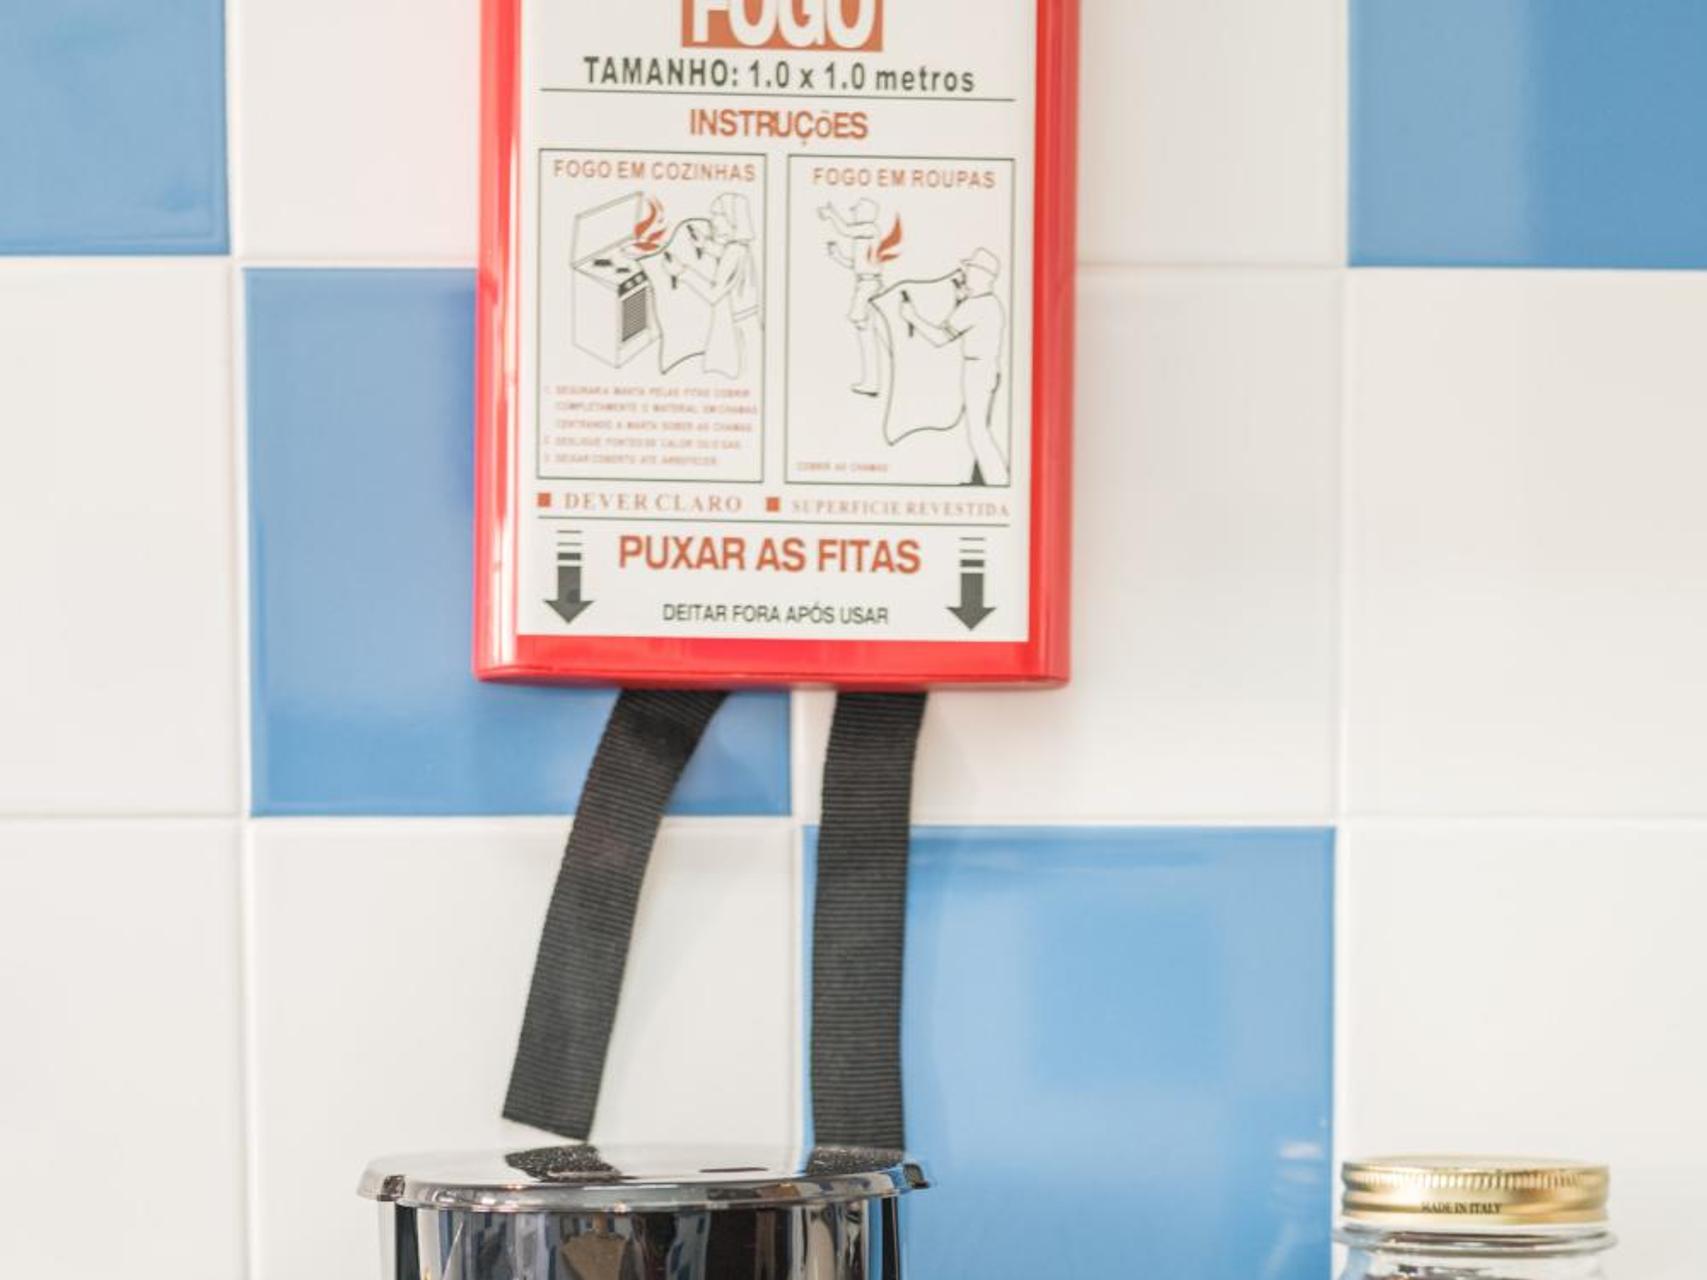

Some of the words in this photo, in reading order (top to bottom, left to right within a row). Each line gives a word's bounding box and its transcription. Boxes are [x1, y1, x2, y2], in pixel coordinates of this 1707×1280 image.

[583, 56, 738, 89] TAMANHO:
[749, 60, 790, 88] 1.0
[799, 68, 814, 88] x
[824, 62, 866, 90] 1.0
[875, 66, 975, 92] metros
[553, 160, 612, 178] FOGO
[617, 162, 645, 179] EM
[652, 163, 756, 182] COZINHAS
[812, 167, 870, 186] FOGO
[877, 169, 906, 187] EM
[911, 169, 996, 189] ROUPAS
[618, 534, 747, 571] PUXAR
[755, 537, 808, 573] AS
[816, 538, 922, 575] FITAS
[663, 603, 727, 622] DEITAR
[732, 604, 781, 623] FORA
[785, 601, 835, 624] APÓS
[840, 606, 889, 625] USAR
